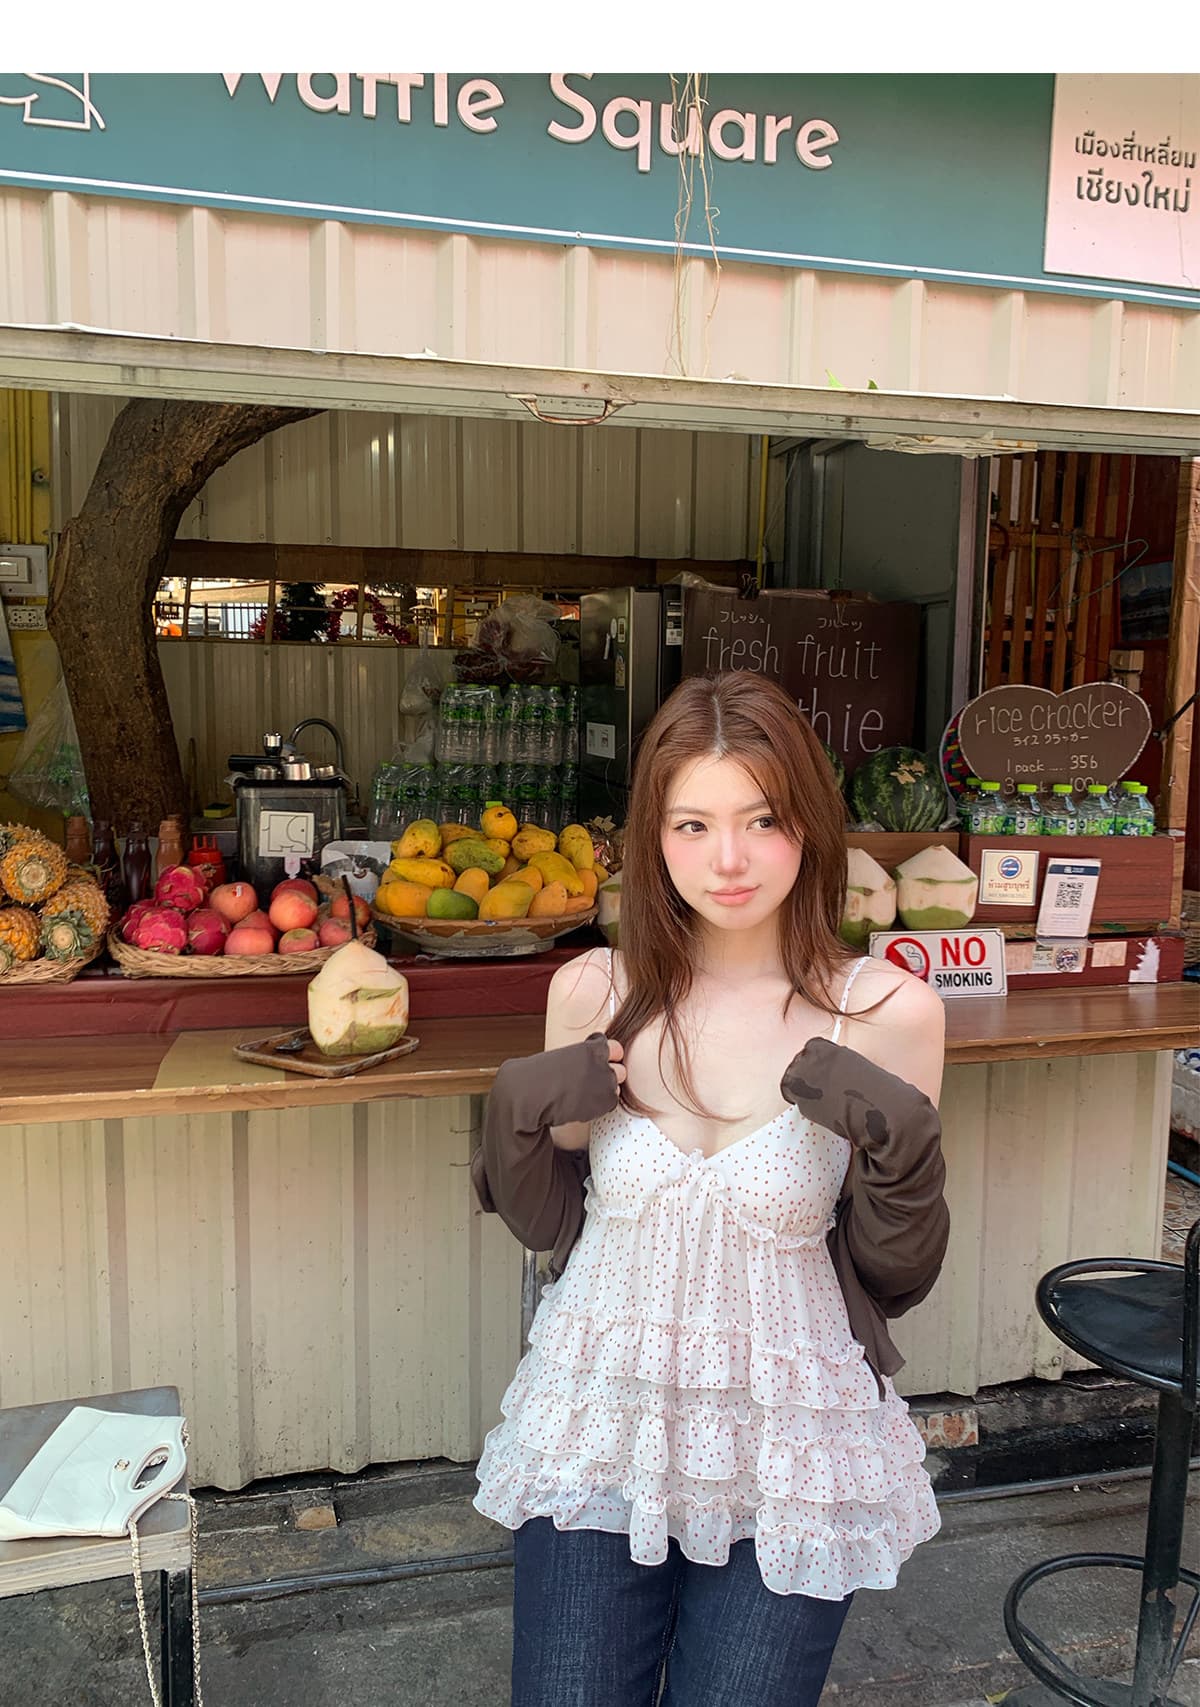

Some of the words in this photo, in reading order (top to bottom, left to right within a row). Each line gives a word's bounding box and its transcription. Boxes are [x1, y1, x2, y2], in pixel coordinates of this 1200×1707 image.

[547, 73, 839, 173] Square
[1076, 167, 1191, 213] เชียงใหม่
[702, 624, 780, 673] fresh
[797, 634, 882, 680] fruit
[975, 706, 1023, 735] rice
[1030, 694, 1131, 732] cracker
[1015, 760, 1045, 773] pack
[940, 936, 986, 967] NO
[935, 972, 993, 988] SMOKING
